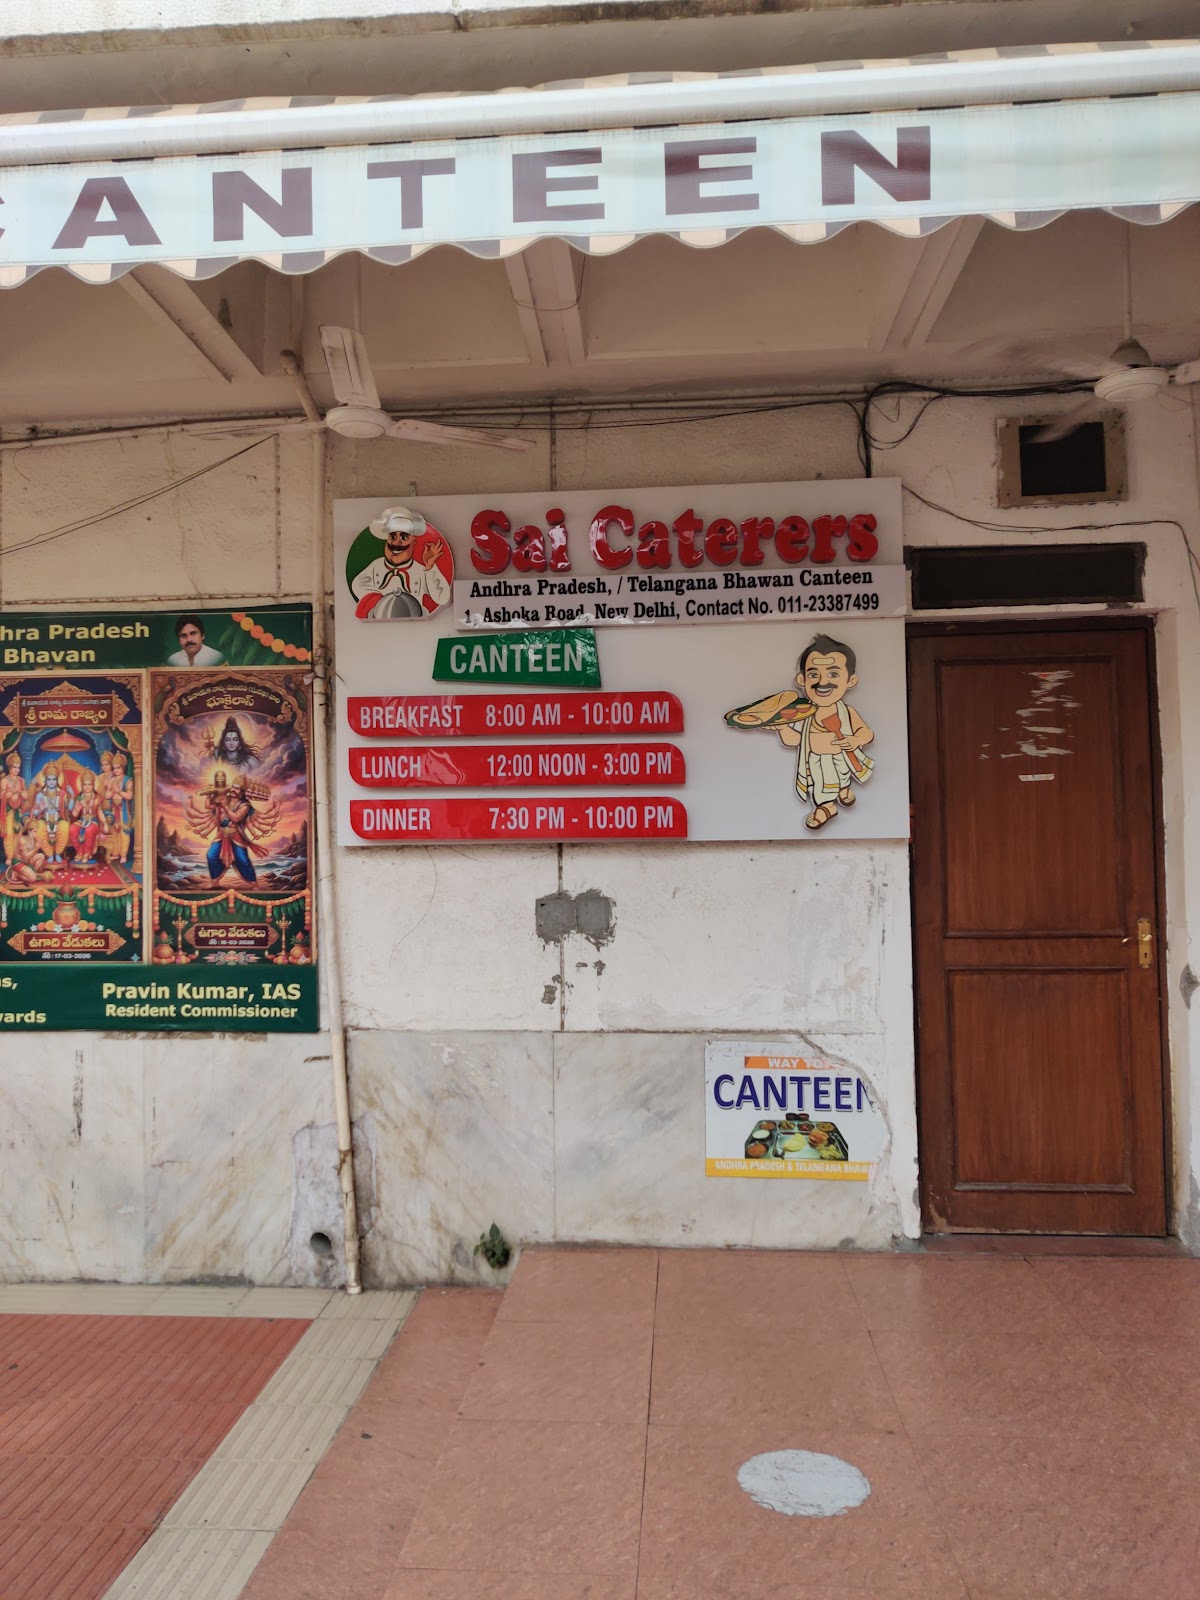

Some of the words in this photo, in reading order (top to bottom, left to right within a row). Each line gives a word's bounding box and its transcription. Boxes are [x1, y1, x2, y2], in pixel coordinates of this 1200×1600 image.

[0, 126, 931, 249] ANTEEN
[470, 508, 572, 575] Sai
[589, 505, 879, 571] Caterers
[470, 581, 532, 598] Andhra
[537, 578, 612, 596] Pradesh,
[628, 575, 718, 596] Telangana
[723, 573, 794, 589] Bhawan
[799, 569, 873, 586] Canteen
[483, 606, 540, 623] Ashoka
[595, 603, 628, 620] New
[634, 601, 680, 620] Delhi,
[685, 598, 744, 617] Contact
[748, 597, 773, 614] No.
[778, 593, 879, 614] 011-23387499
[49, 622, 149, 640] Pradesh
[4, 648, 96, 664] Bhavan
[450, 643, 583, 674] CANTEEN
[25, 707, 37, 724] శ్రీ
[39, 708, 68, 720] రామ
[70, 708, 107, 724] రాజ్యం
[360, 704, 463, 729] BREAKFAST
[485, 703, 525, 727] 8:00
[532, 703, 561, 726] AM
[582, 702, 633, 725] 10:00
[639, 701, 670, 724] AM
[361, 755, 422, 779] LUNCH
[487, 754, 532, 777] 12:00
[538, 753, 586, 776] NOON
[603, 752, 639, 775] 3:00
[645, 751, 672, 775] PM
[363, 807, 431, 831] DINNER
[488, 807, 528, 830] 7:30
[535, 806, 564, 829] PM
[584, 806, 637, 829] 10:00
[644, 805, 673, 829] PM
[29, 936, 60, 948] ఉగాది
[62, 934, 105, 948] వేడుకలు
[198, 927, 227, 938] ఉగాది
[228, 926, 266, 938] వేడుకలు
[0, 977, 18, 990] s,
[102, 981, 170, 1000] Pravin
[178, 981, 255, 1003] Kumar,
[262, 983, 301, 1000] IAS
[105, 1003, 176, 1018] Resident
[180, 1003, 298, 1018] Commissioner
[768, 1058, 800, 1068] WAY
[715, 1160, 748, 1170] ANDHRA
[749, 1161, 784, 1171] PRADESH
[787, 1163, 793, 1171] &
[796, 1163, 842, 1173] TELANGANA
